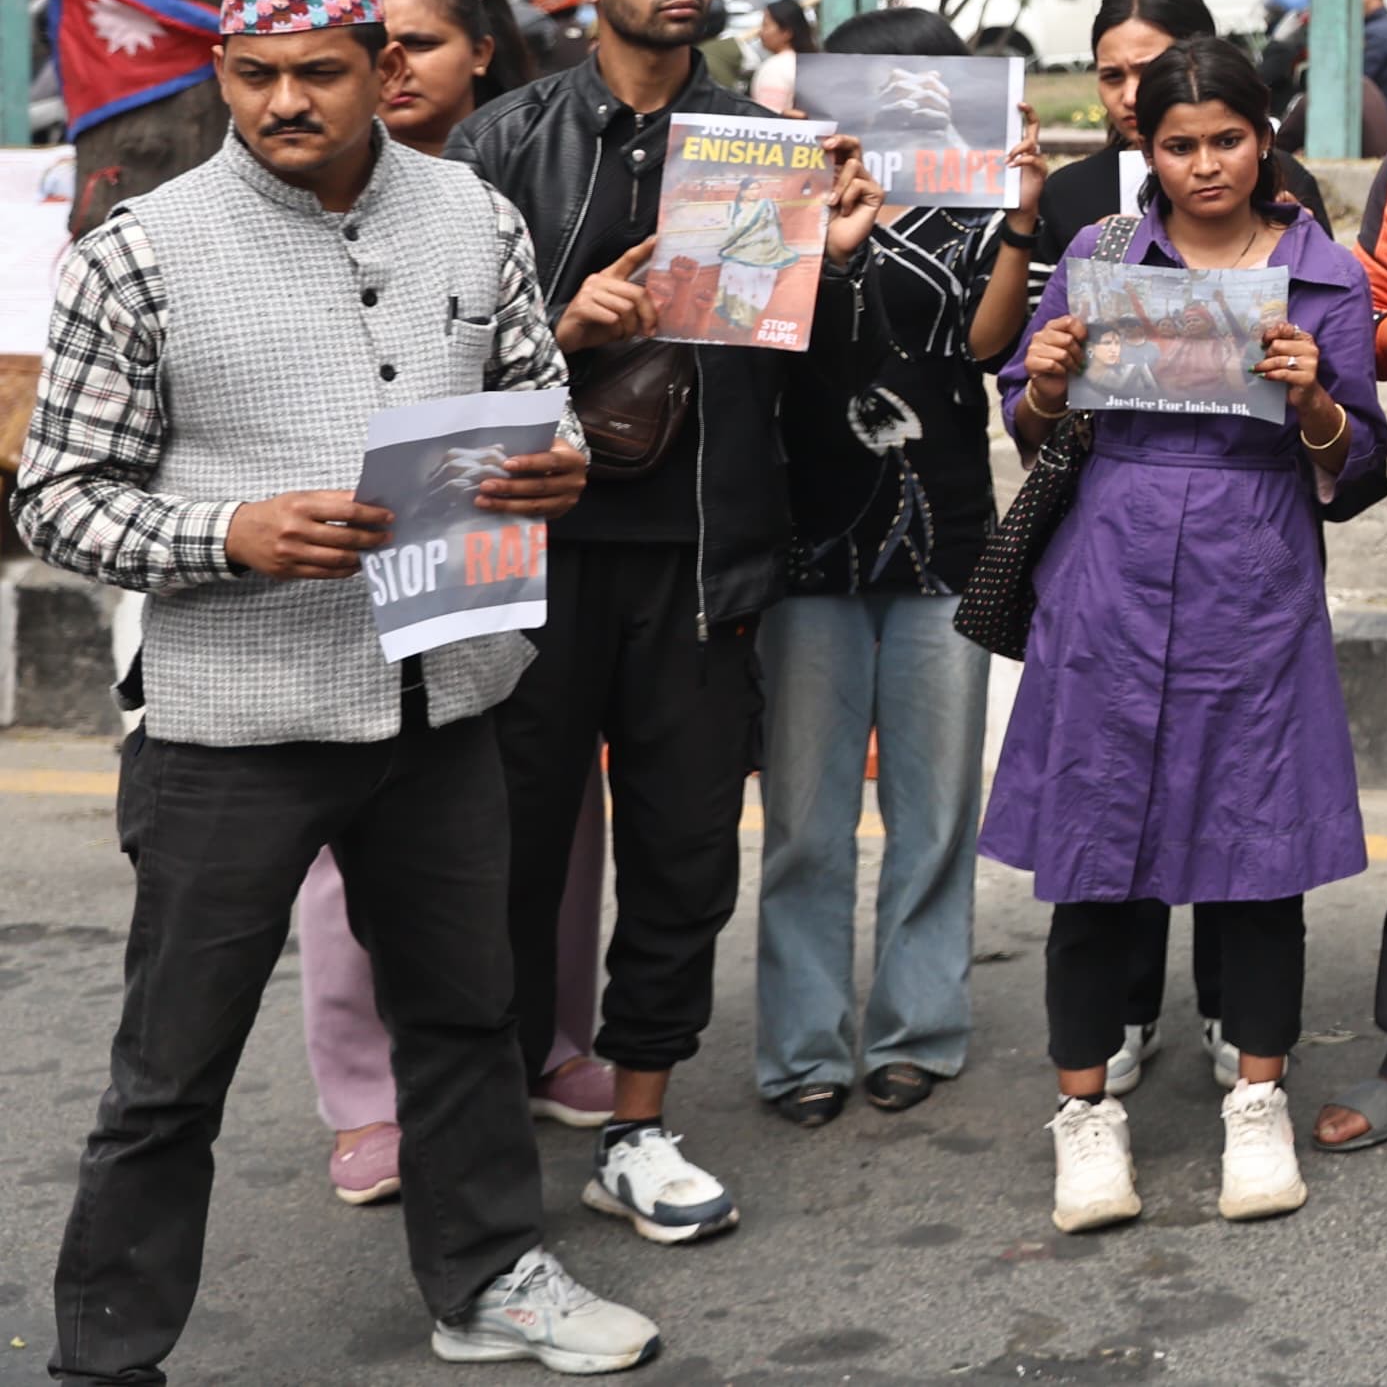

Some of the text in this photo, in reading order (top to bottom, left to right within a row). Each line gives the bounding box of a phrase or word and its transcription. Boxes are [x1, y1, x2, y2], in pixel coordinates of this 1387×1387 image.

[682, 136, 827, 170] ENISHA BK
[863, 148, 1005, 194] OP RAPE
[757, 330, 797, 344] RAPE!
[761, 318, 797, 332] STOP
[1105, 395, 1250, 415] Justice For Inisha Bk
[366, 523, 547, 606] STOP RAP
